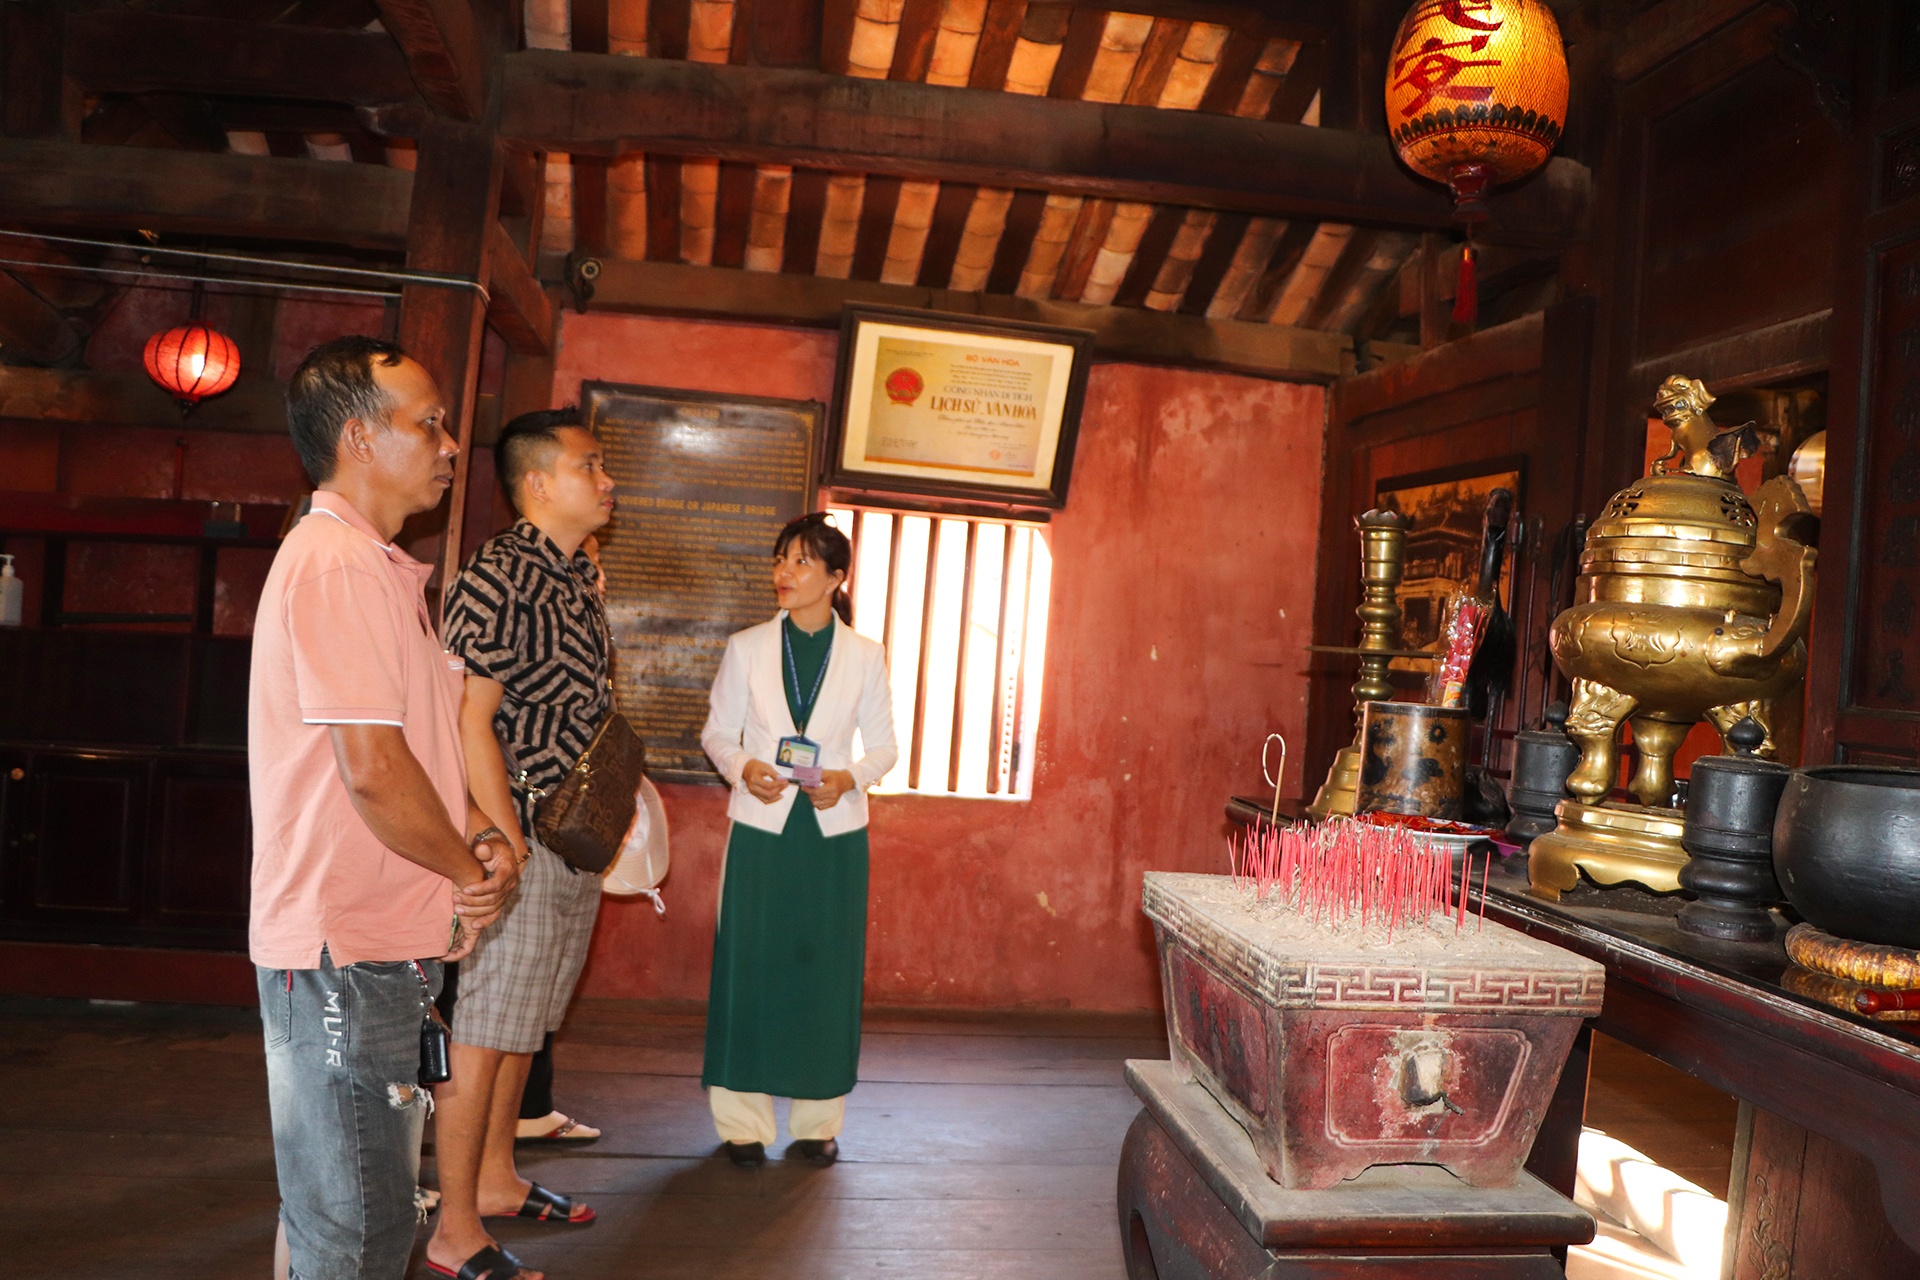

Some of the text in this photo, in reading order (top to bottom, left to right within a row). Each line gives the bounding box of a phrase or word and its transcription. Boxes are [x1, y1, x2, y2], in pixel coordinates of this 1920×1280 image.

[617, 494, 777, 516] COVERED BRIDGE OR JAPANESE BRIDGE
[323, 990, 343, 1067] MU-R
